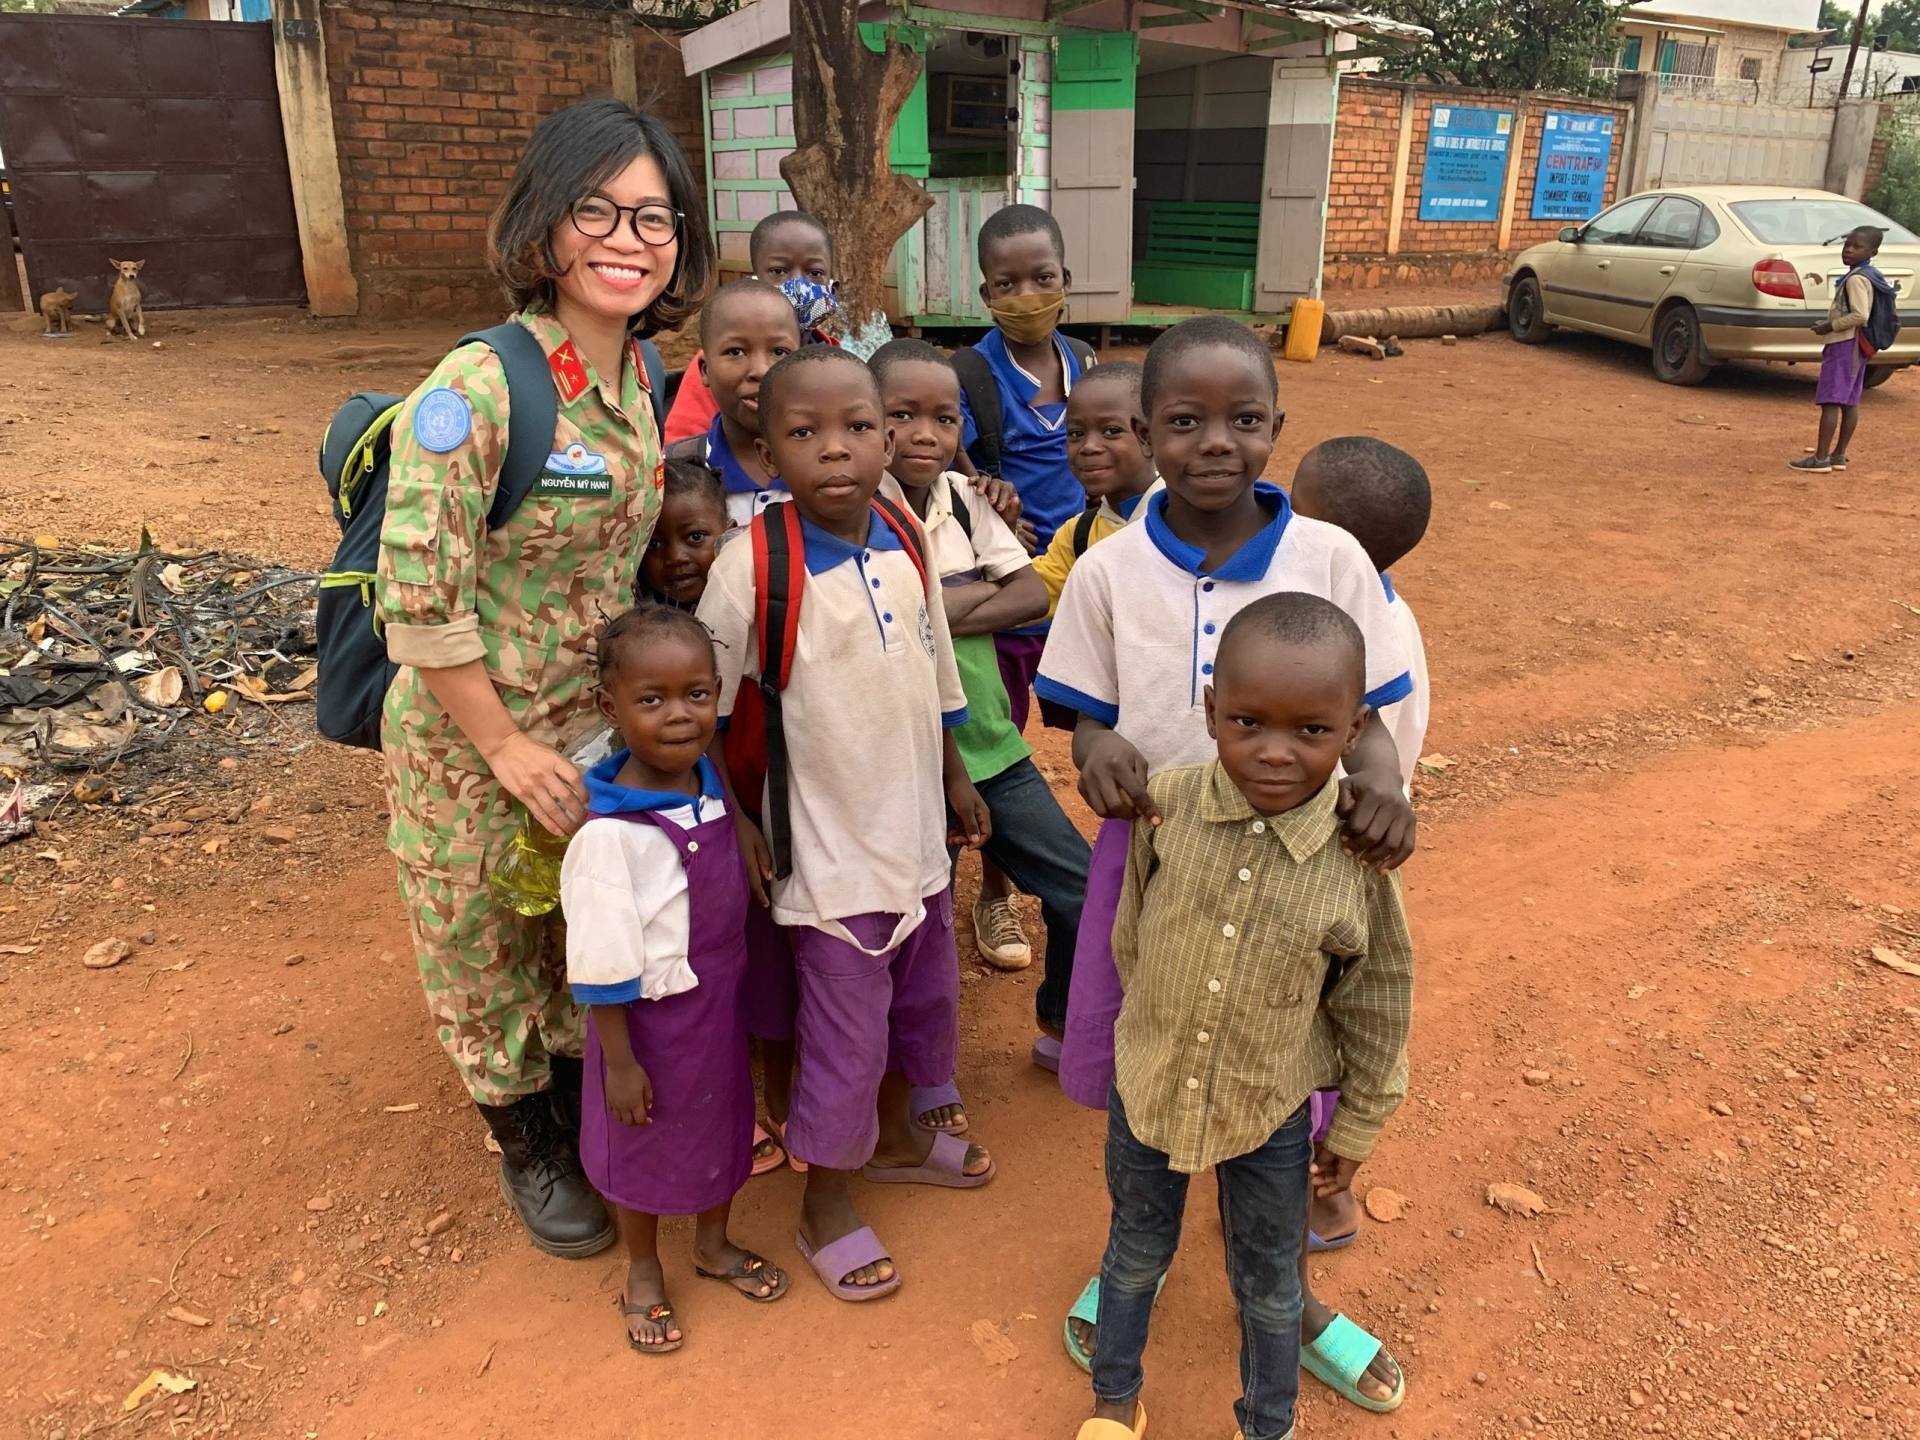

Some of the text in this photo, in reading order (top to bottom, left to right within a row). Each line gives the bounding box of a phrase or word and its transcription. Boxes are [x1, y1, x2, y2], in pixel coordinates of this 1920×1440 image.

[1549, 172, 1568, 184] IMPORT
[1571, 174, 1590, 185] EXPORT
[1543, 190, 1569, 202] COMMERCE
[541, 476, 609, 490] NGUYỄN MỸ HẠNH
